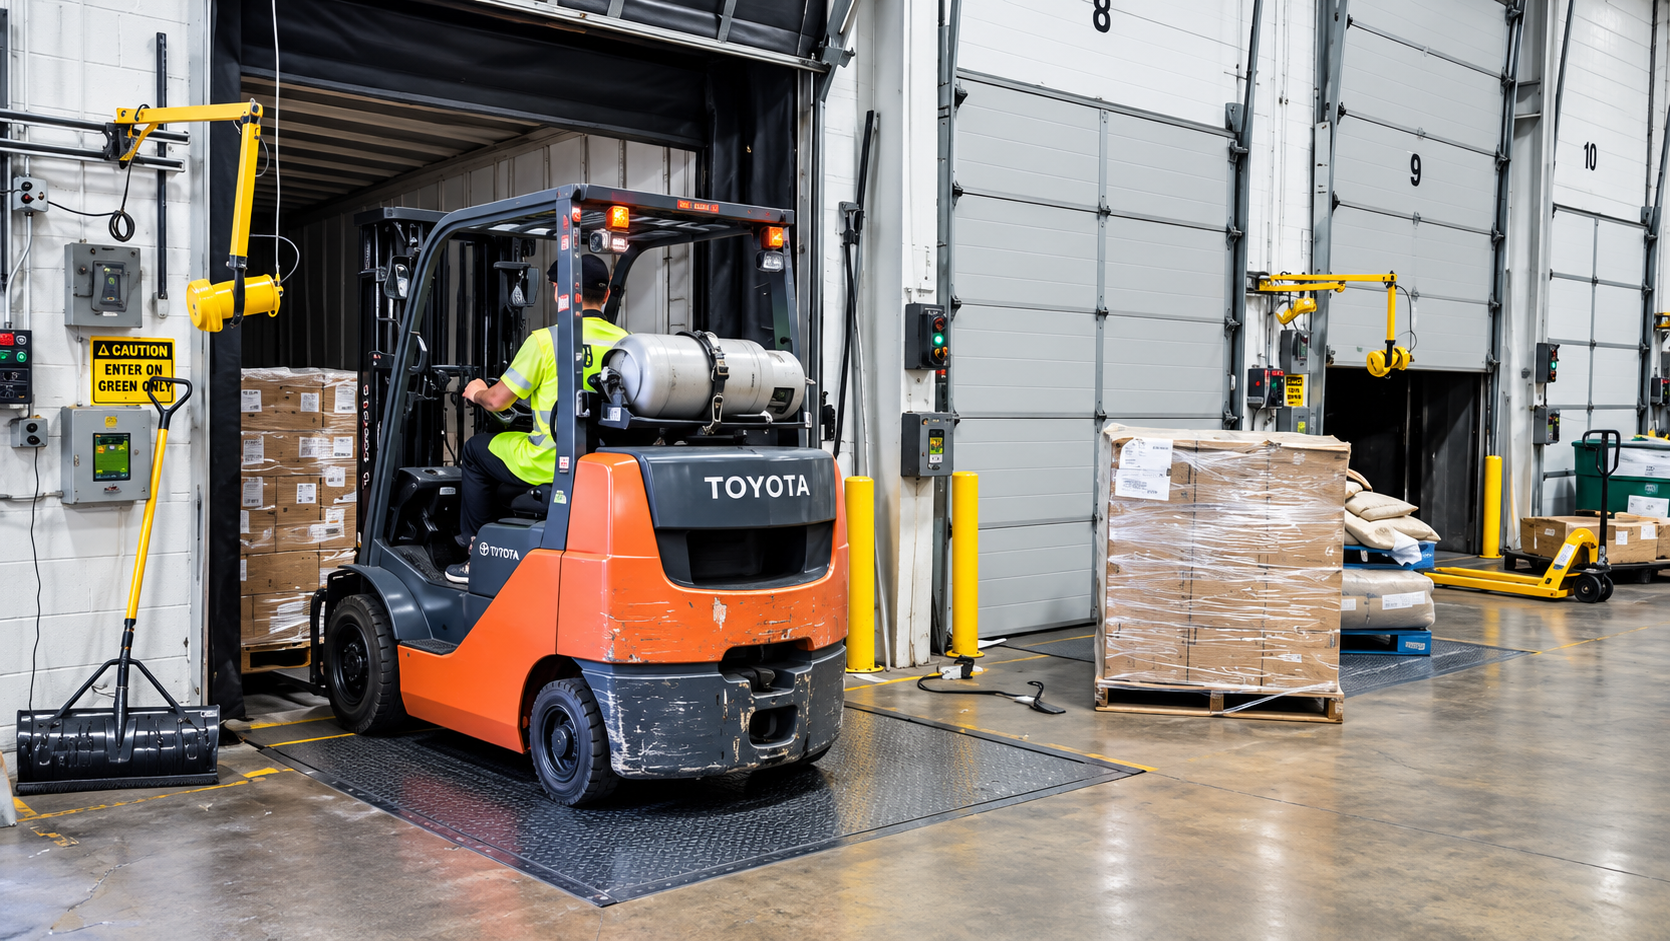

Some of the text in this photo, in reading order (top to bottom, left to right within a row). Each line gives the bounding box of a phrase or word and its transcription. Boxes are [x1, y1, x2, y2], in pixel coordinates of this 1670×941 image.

[1093, 0, 1110, 33] 8
[1583, 141, 1597, 171] 10
[1410, 153, 1421, 187] 9
[112, 344, 168, 357] CAUTION
[105, 363, 163, 376] ENTER ON
[98, 379, 172, 393] GREEN ONLY
[704, 474, 810, 499] TOYOTA
